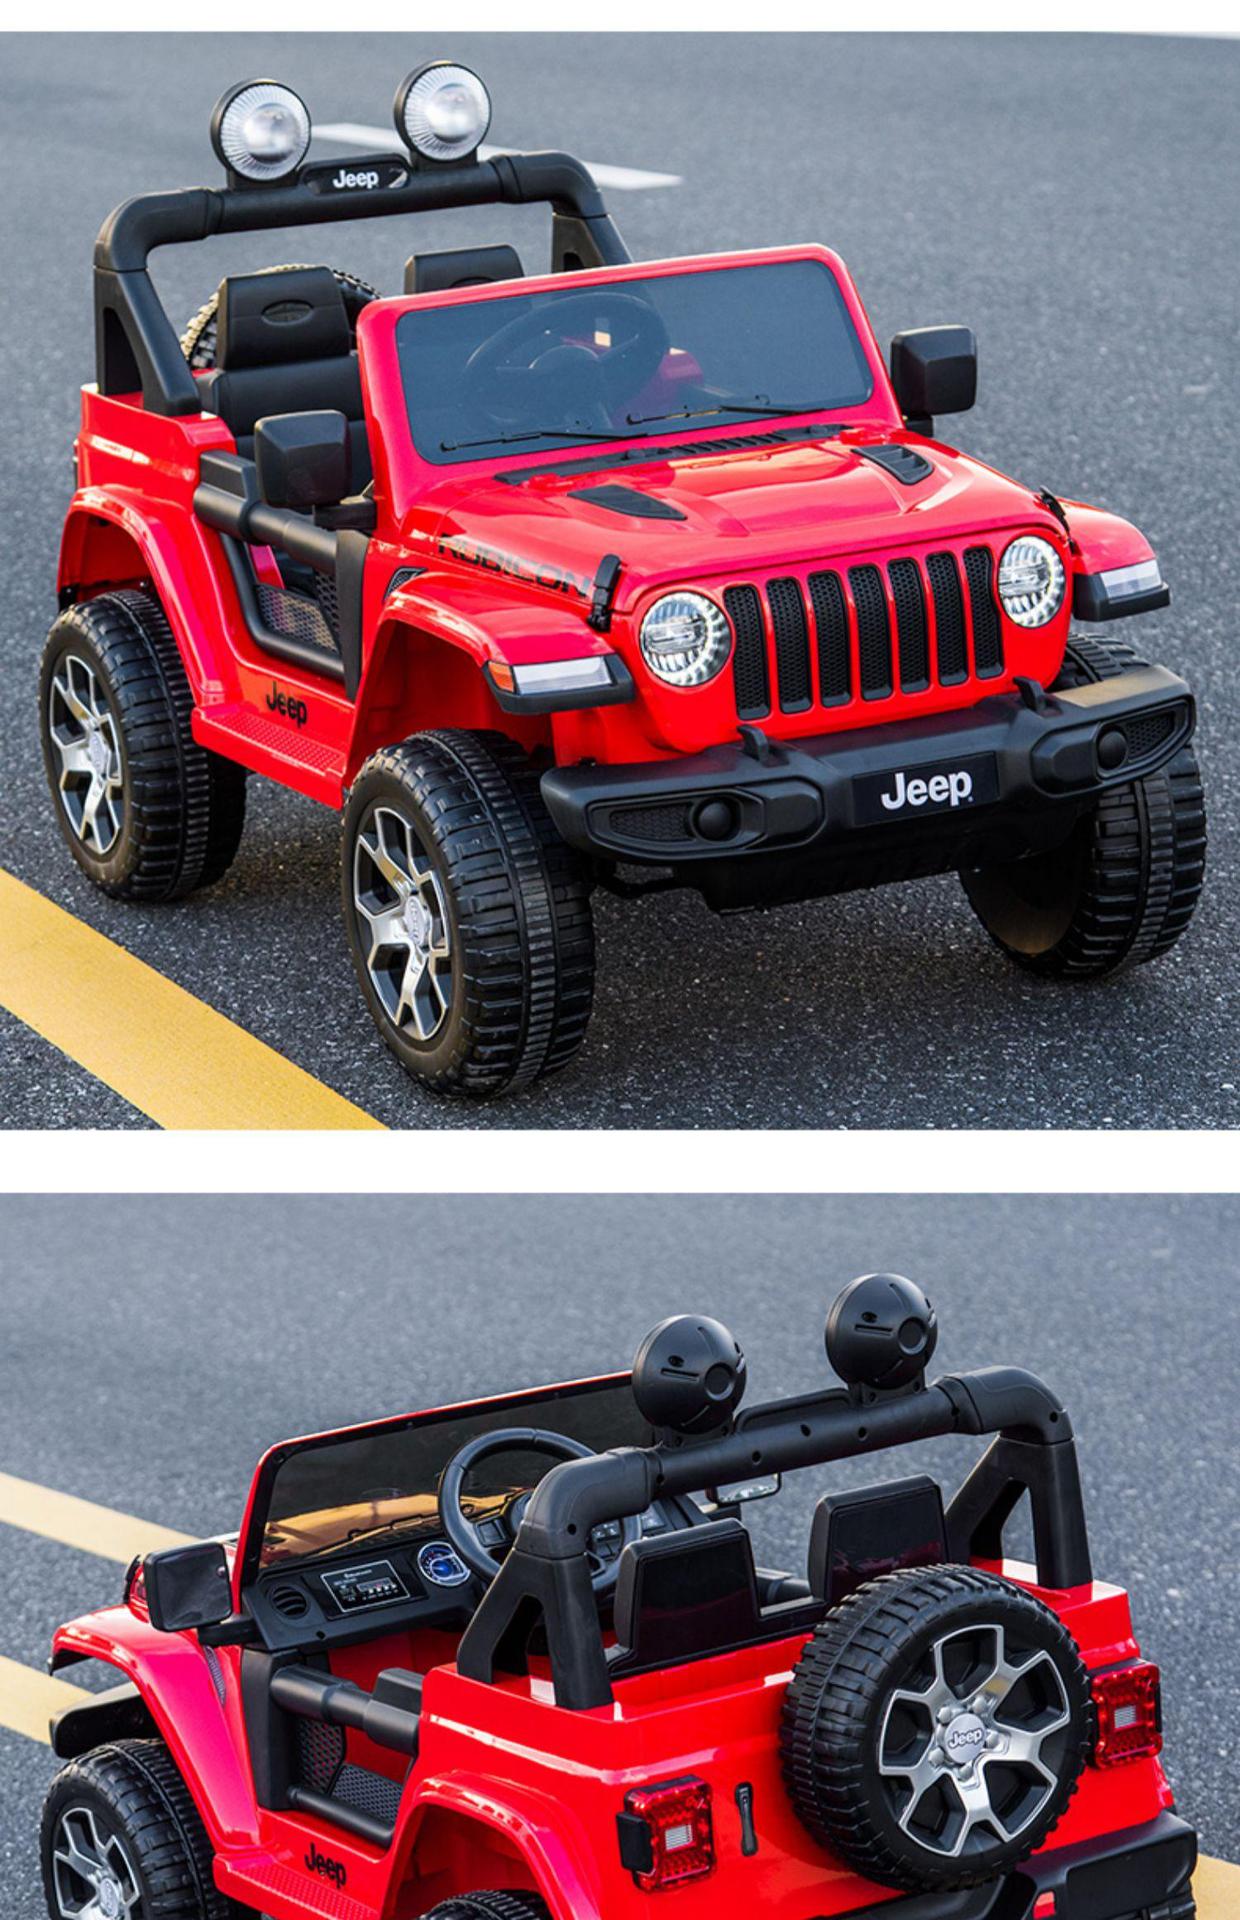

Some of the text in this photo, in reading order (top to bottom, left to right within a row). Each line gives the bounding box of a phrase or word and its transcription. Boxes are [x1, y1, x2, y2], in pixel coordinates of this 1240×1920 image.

[332, 169, 379, 189] Jeep
[437, 533, 591, 598] RUBICON
[266, 681, 307, 728] Jeep
[881, 771, 974, 810] Jeep
[949, 1729, 983, 1749] Jeep
[304, 1841, 346, 1888] Jeep
